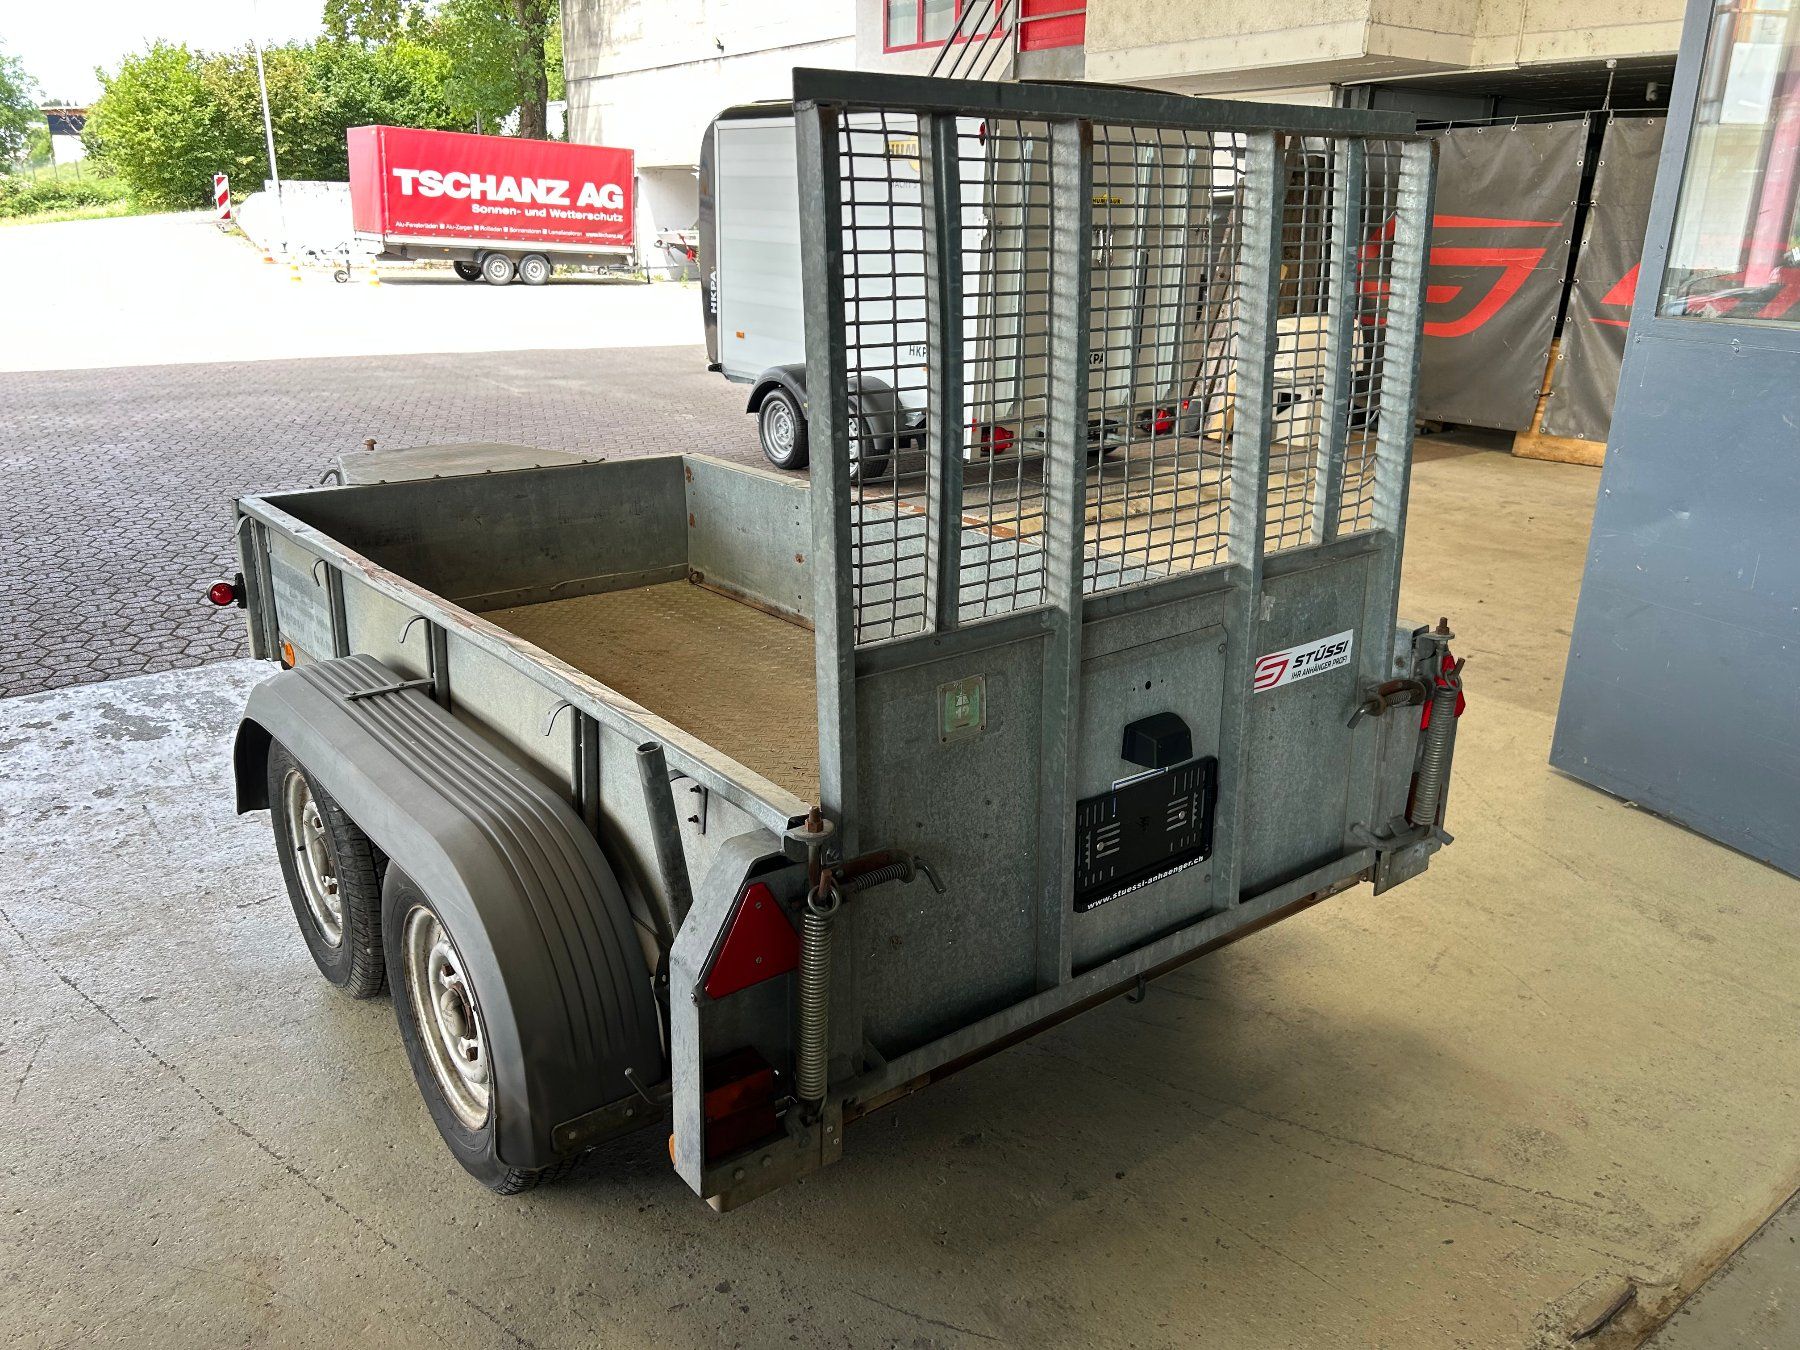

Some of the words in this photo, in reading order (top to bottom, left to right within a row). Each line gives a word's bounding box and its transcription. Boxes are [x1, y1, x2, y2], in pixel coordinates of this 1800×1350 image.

[392, 168, 571, 206] TSCHANZ
[576, 182, 624, 210] AG
[471, 203, 521, 216] Sonnen-
[525, 208, 547, 217] und
[549, 209, 624, 222] Wetterschutz
[1291, 669, 1302, 680] IHR
[1302, 660, 1332, 676] ANHÄNGER
[1332, 655, 1348, 667] PROFI
[1292, 640, 1350, 669] STÜSSI
[1087, 855, 1205, 910] www.stuessi-anhaenger.ch
